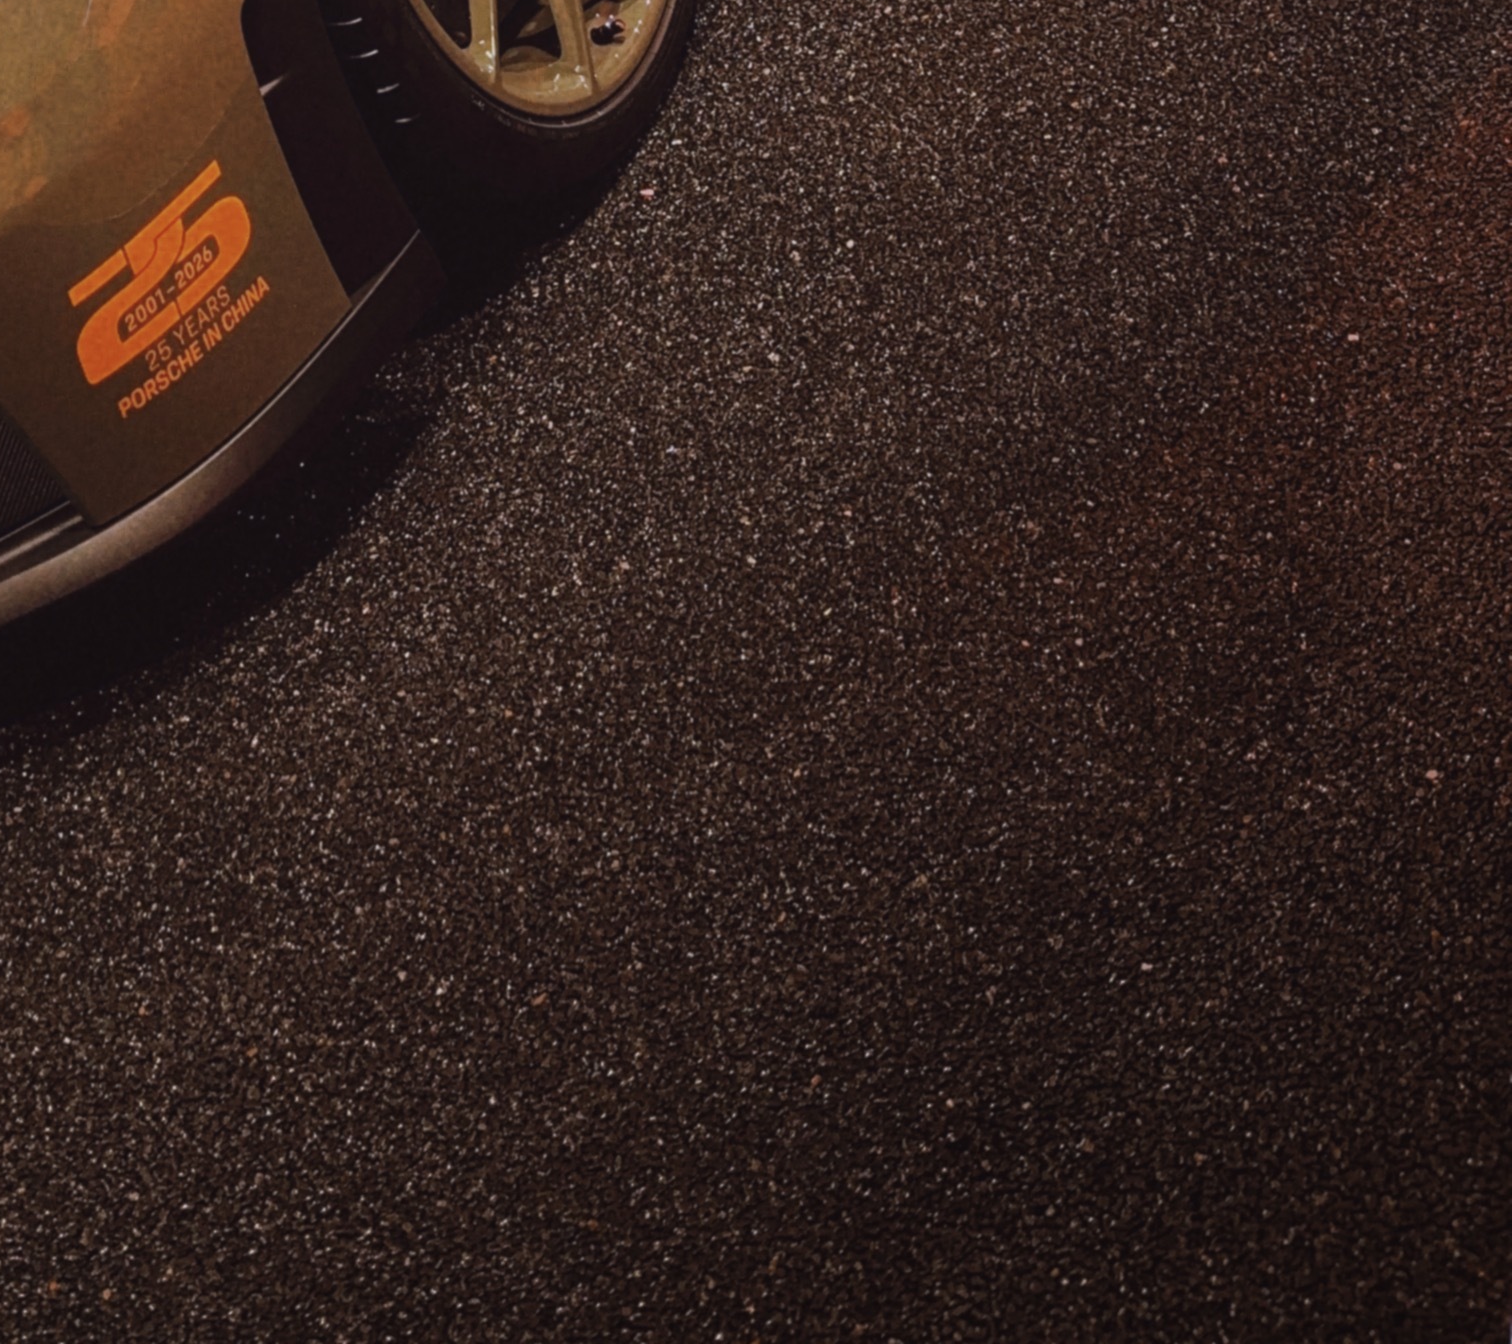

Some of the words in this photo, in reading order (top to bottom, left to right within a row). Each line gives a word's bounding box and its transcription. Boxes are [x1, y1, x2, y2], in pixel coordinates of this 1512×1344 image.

[124, 245, 214, 333] 2001-2026
[144, 343, 172, 372] 25
[173, 284, 232, 346] YEARS
[117, 348, 204, 419] PORSCHE
[205, 325, 223, 352] IN
[221, 275, 271, 333] CHINA
